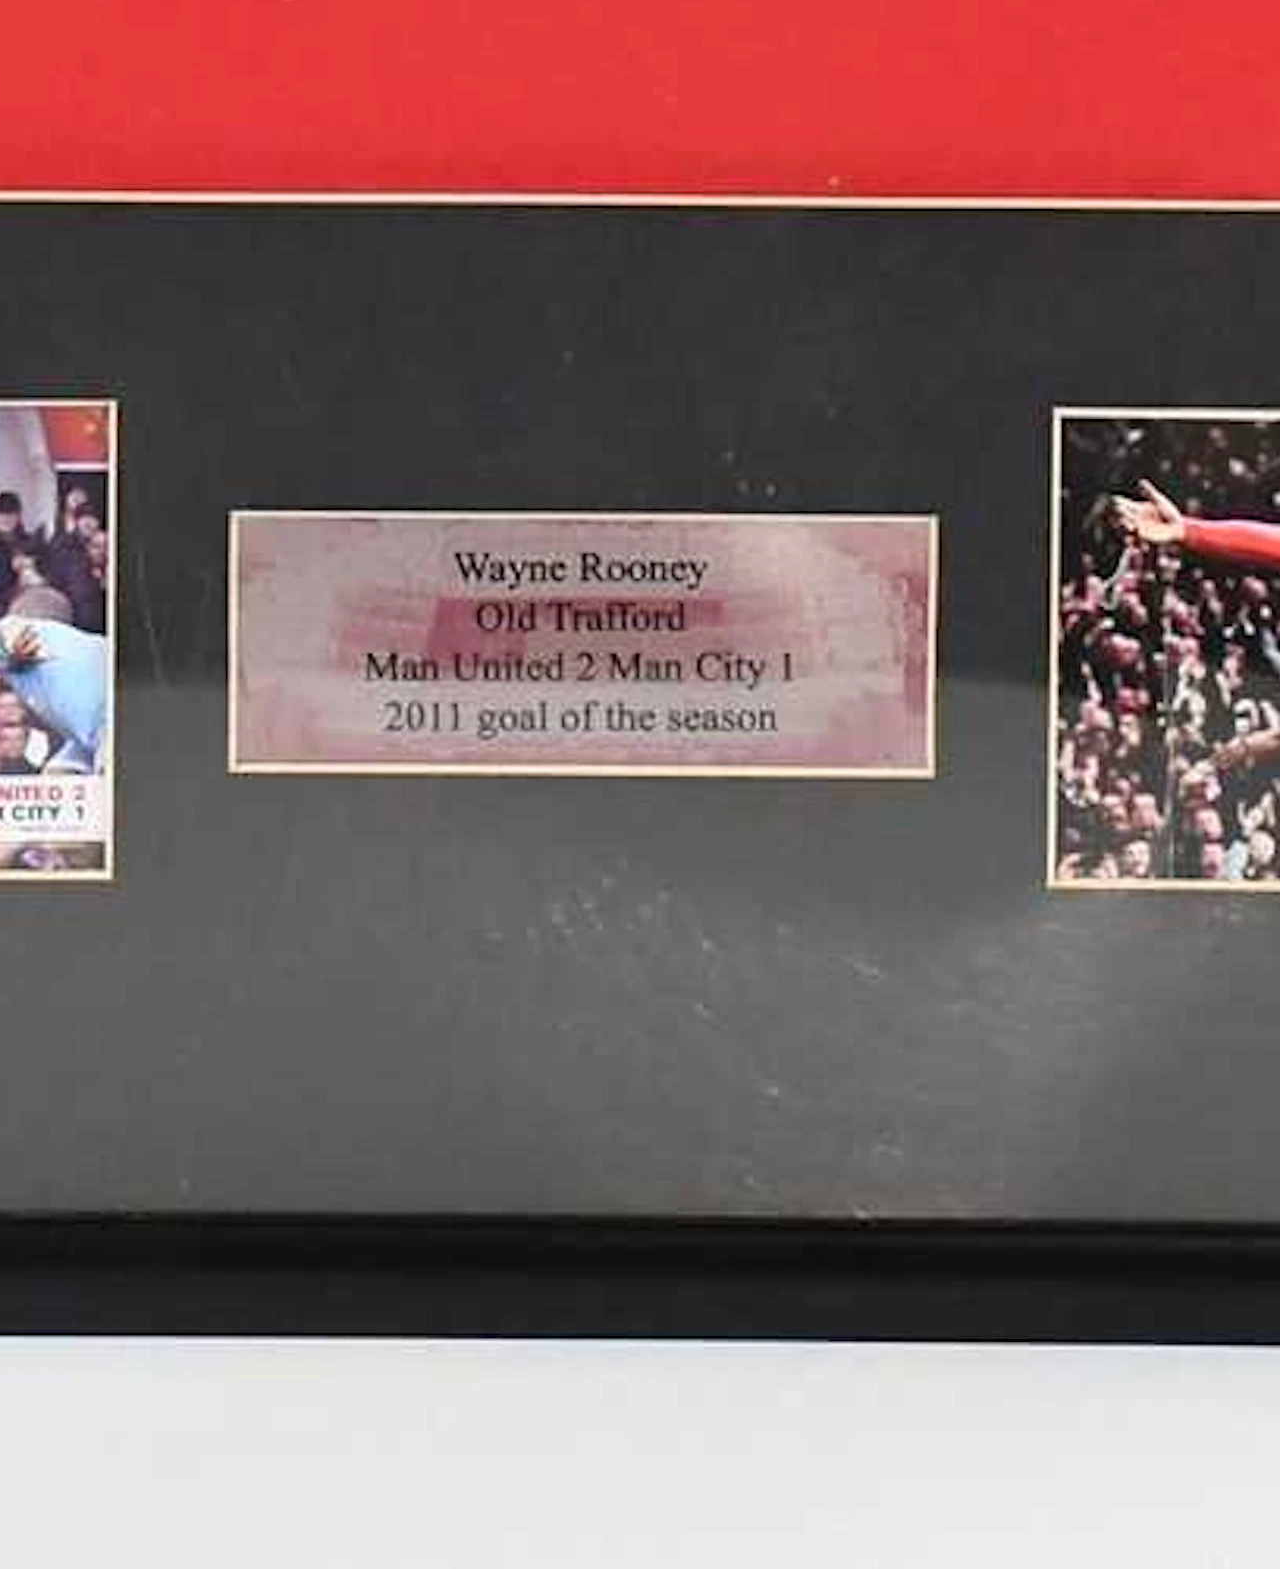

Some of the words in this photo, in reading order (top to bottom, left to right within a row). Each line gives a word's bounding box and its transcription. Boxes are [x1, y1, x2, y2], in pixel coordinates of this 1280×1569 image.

[453, 551, 569, 591] Wayne
[579, 551, 708, 590] Rooney
[475, 601, 537, 632] Old
[546, 600, 685, 632] Trafford
[364, 652, 440, 682] Man
[452, 651, 564, 682] United
[576, 651, 597, 682] 2
[608, 651, 684, 682] Man
[695, 651, 766, 691] City
[781, 651, 793, 682] 1
[382, 700, 461, 732] 2011
[475, 701, 549, 741] goal
[560, 699, 600, 732] of
[605, 701, 657, 732] the
[665, 708, 779, 732] season
[74, 785, 86, 802] 2
[11, 805, 62, 822] CITY
[75, 806, 85, 822] 1
